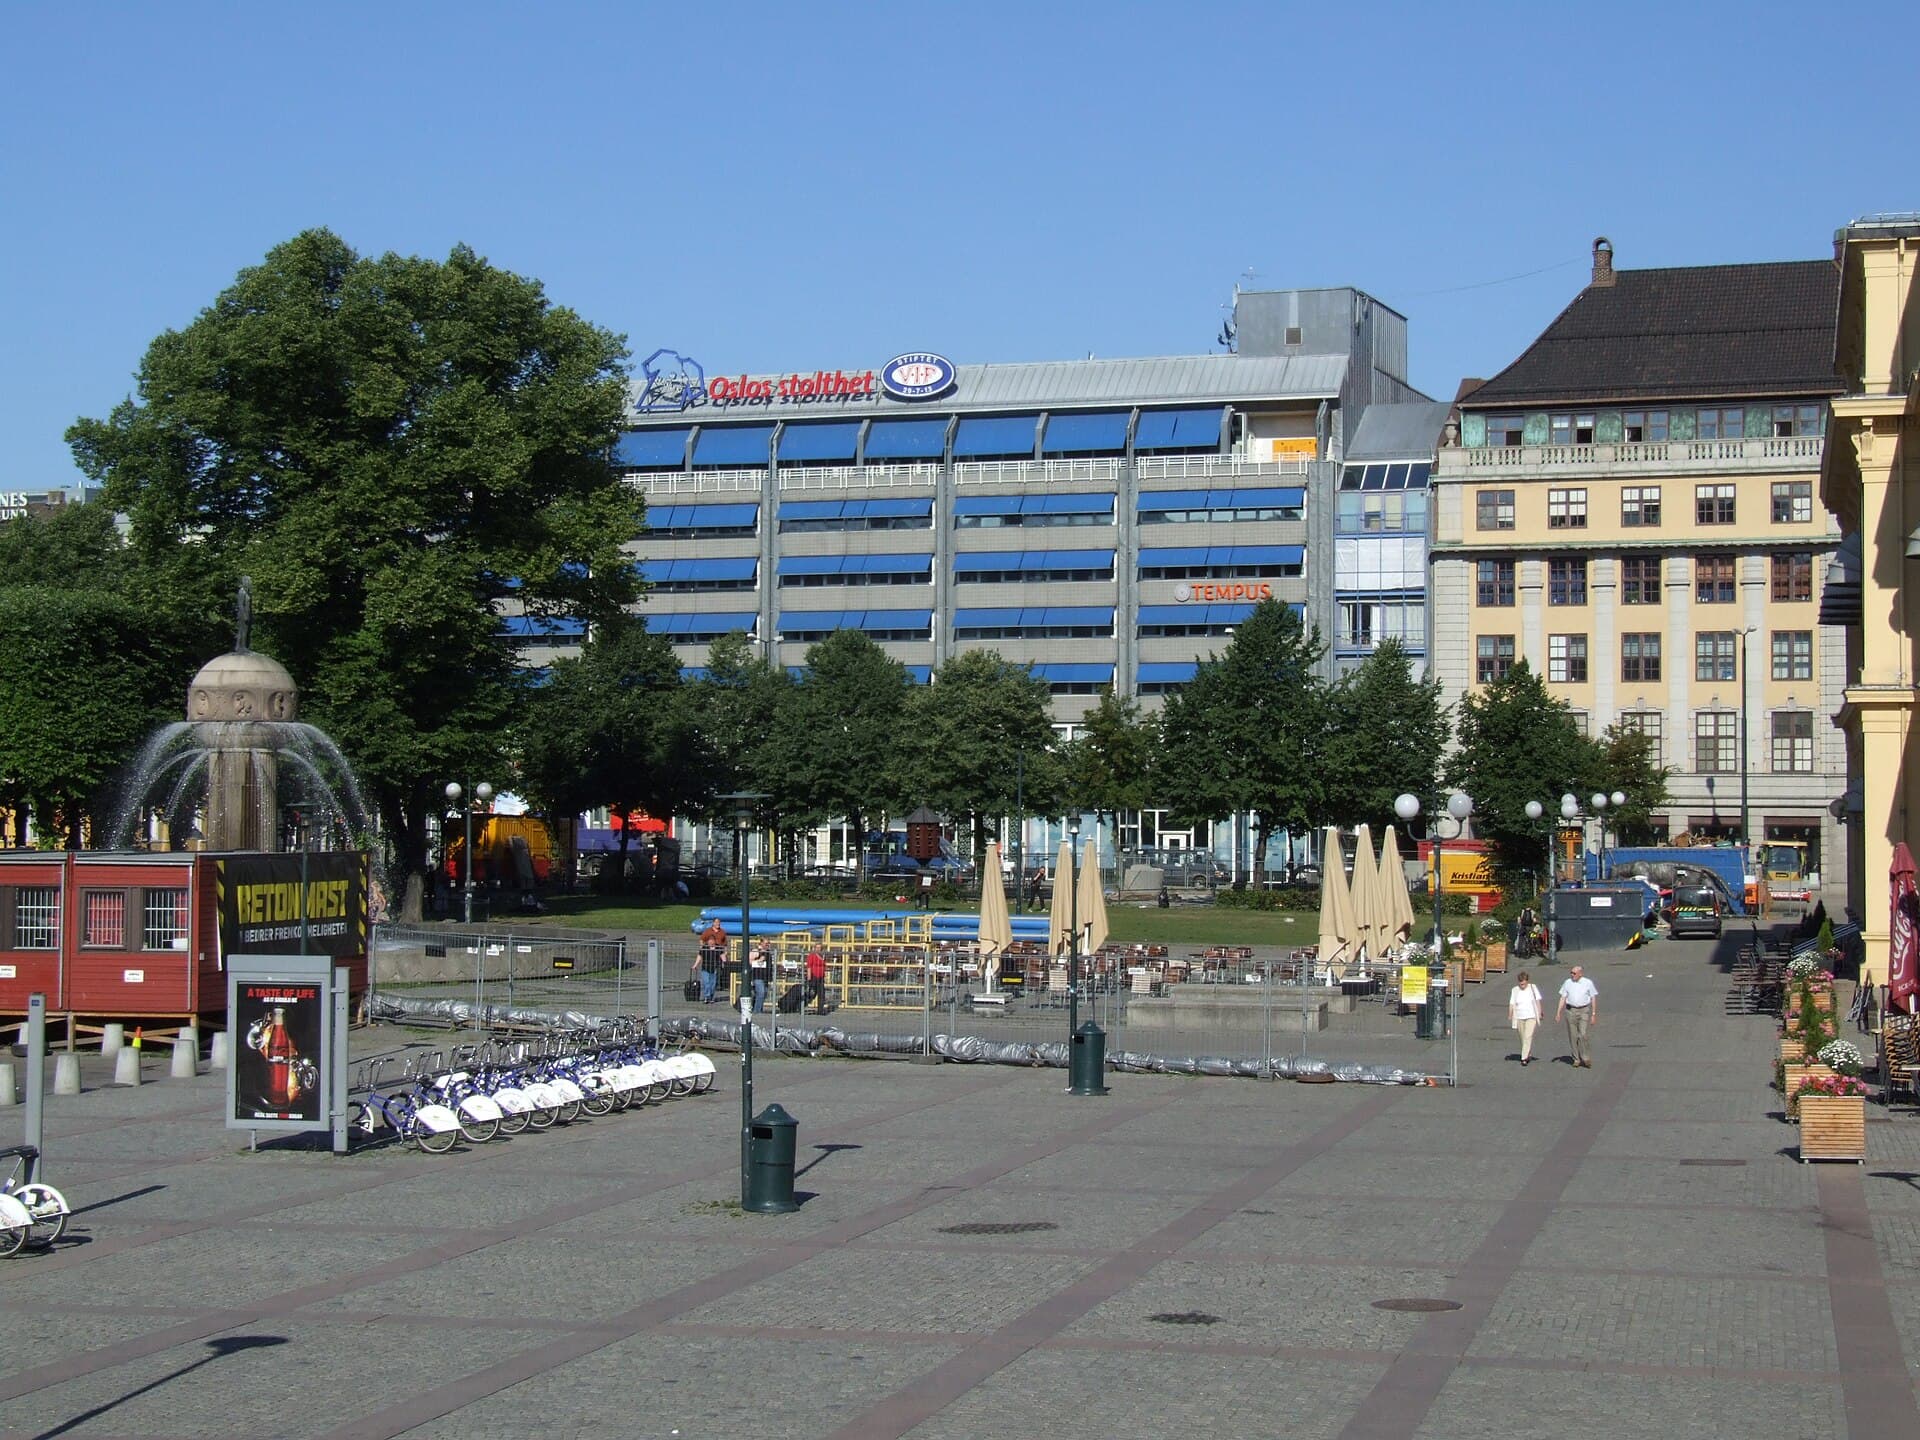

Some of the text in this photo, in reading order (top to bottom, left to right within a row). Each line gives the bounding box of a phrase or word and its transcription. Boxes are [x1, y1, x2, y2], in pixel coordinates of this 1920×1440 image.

[897, 355, 938, 366] STIFTET
[709, 370, 874, 399] Oslos stolthet
[1191, 583, 1272, 601] TEMPUS
[237, 880, 349, 924] BETONMAST
[275, 922, 348, 941] FREMKOMELIGHETE
[248, 988, 315, 998] A TASTE OF LIFE
